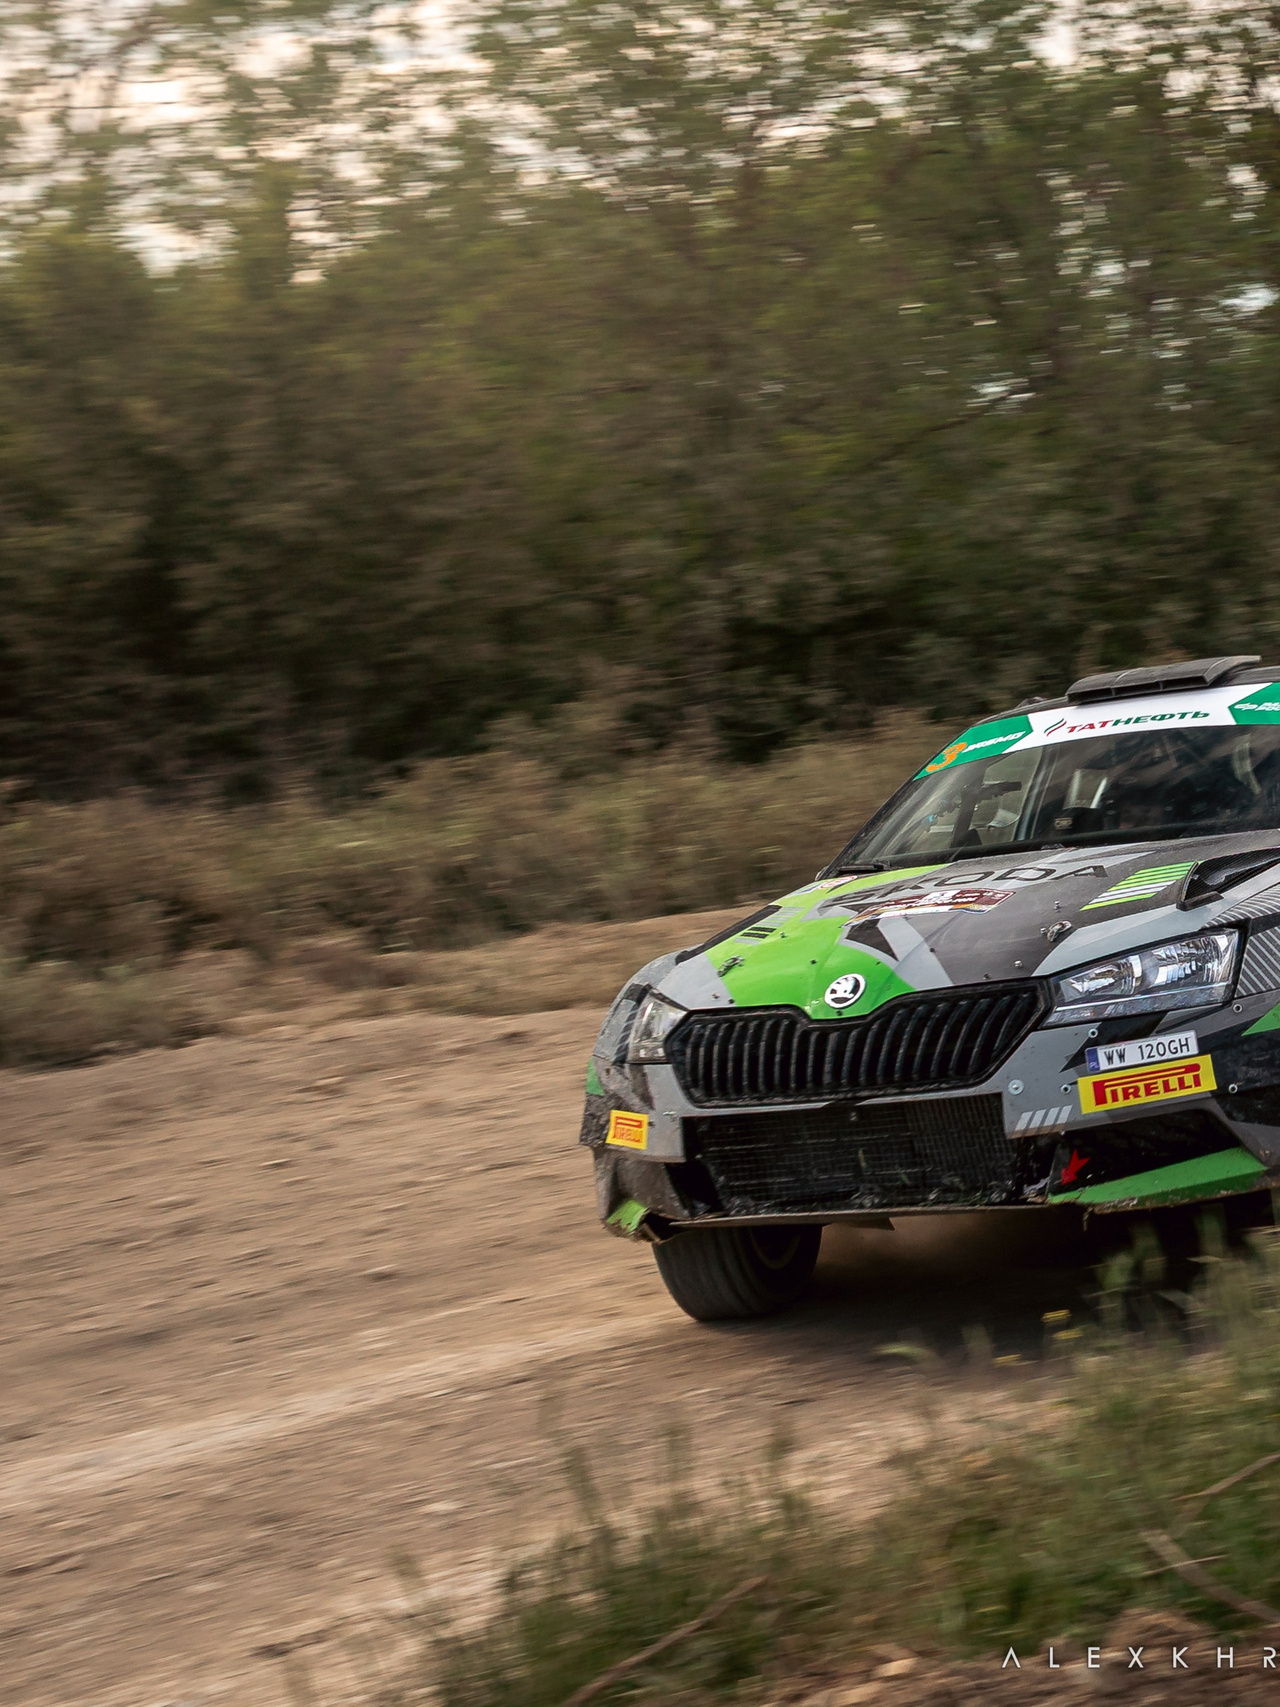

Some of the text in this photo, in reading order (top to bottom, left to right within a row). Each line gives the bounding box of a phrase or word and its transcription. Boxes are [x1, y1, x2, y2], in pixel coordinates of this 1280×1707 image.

[1066, 710, 1211, 734] ТАТНЕФТЬ
[925, 741, 968, 773] 3
[1103, 1036, 1191, 1066] WW 120GH
[1091, 1062, 1202, 1107] PIRELLI
